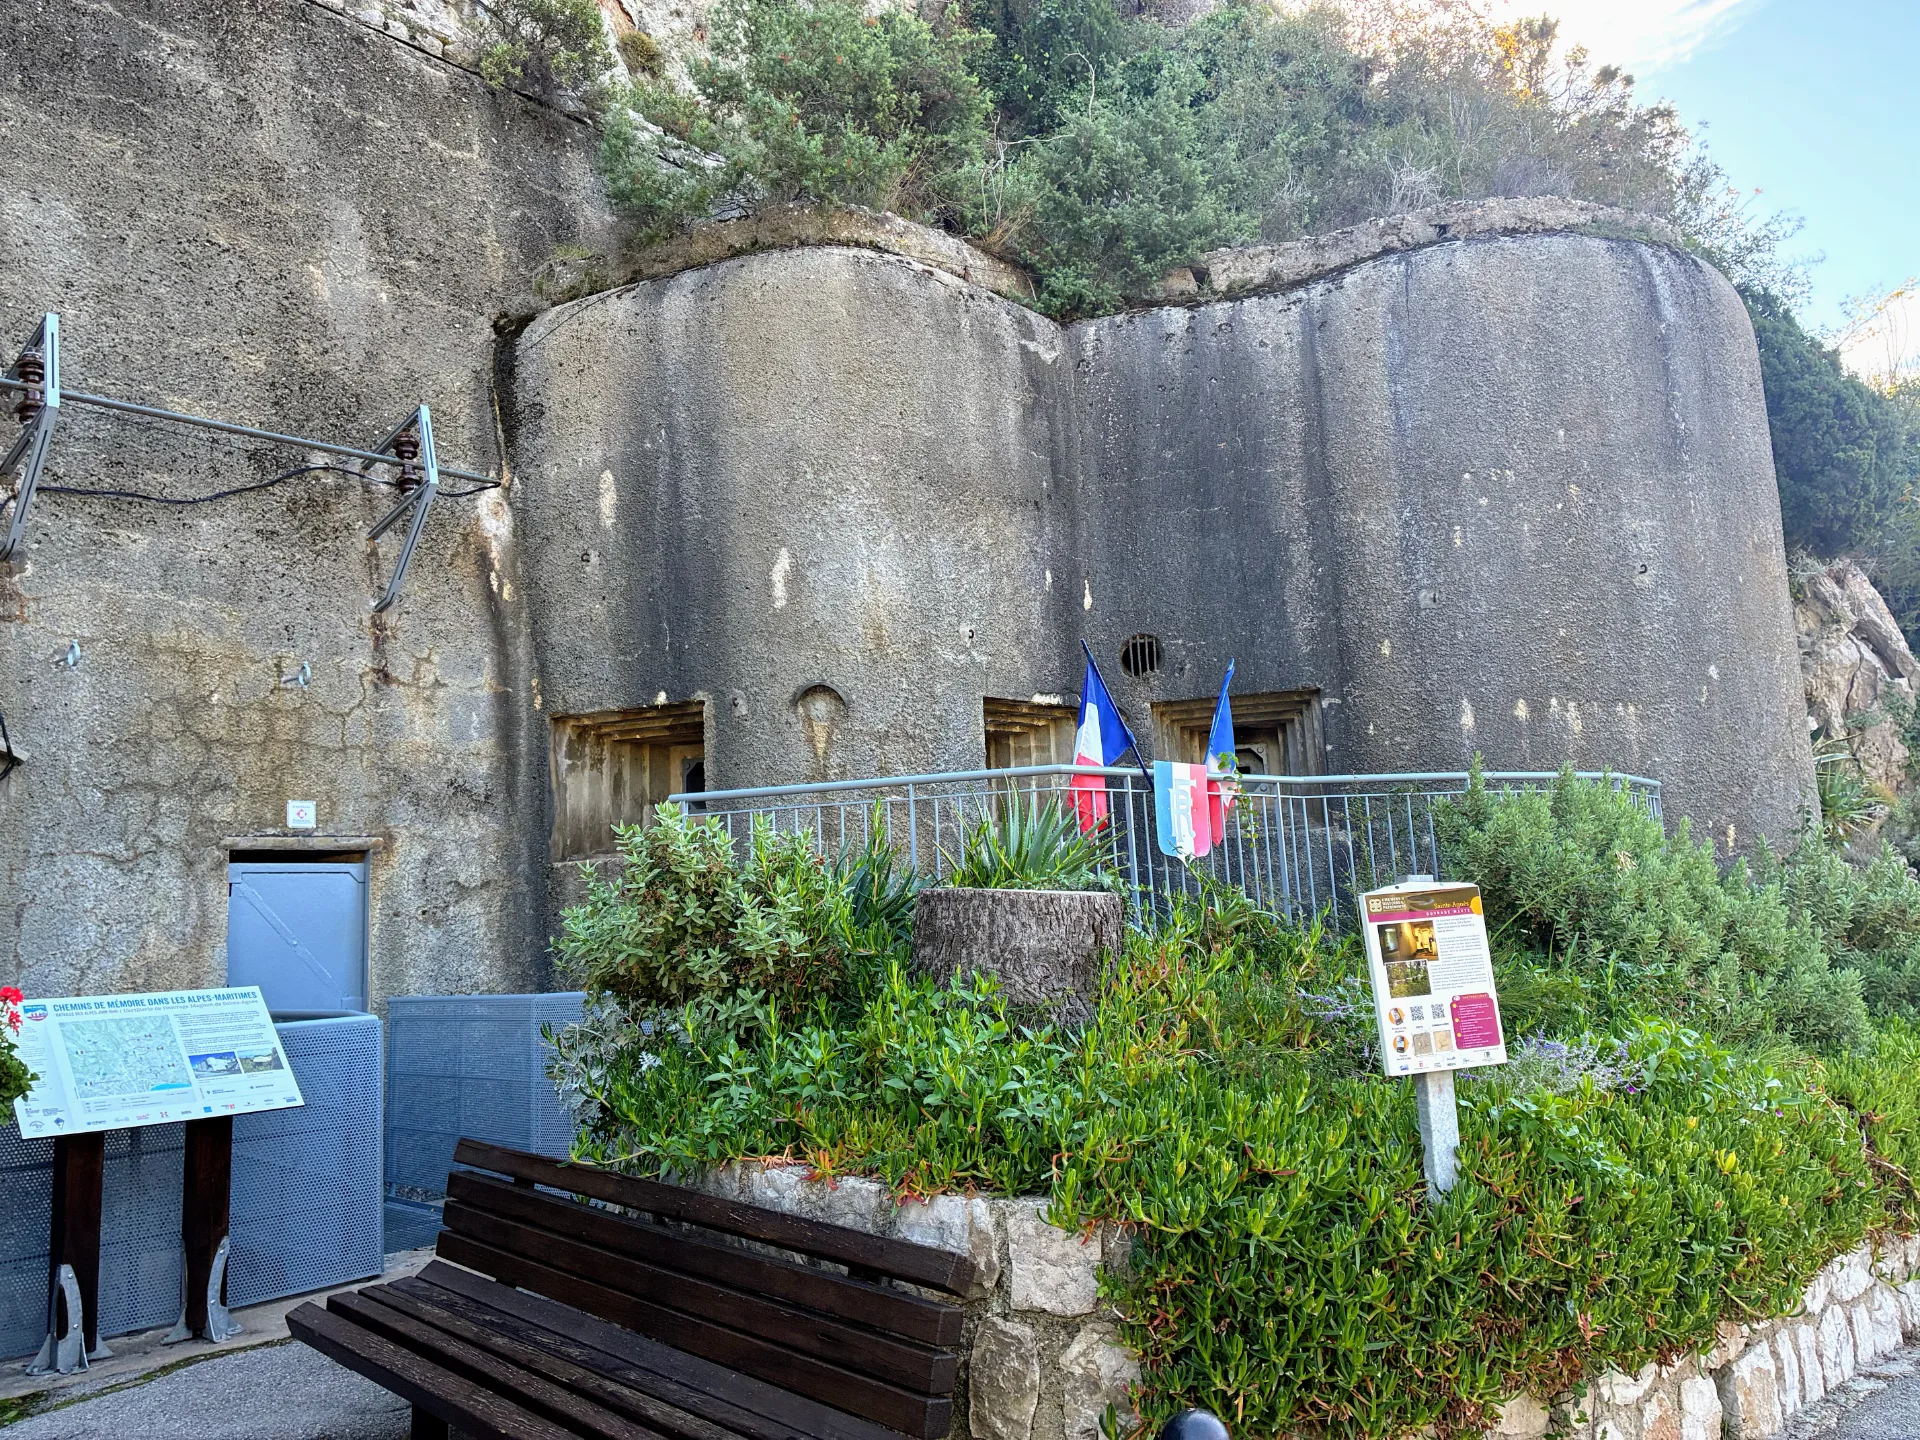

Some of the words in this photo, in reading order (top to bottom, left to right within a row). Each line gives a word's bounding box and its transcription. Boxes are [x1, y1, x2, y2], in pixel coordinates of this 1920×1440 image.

[1433, 901, 1470, 910] Sainte-Agnès
[1426, 909, 1451, 917] OUVRAGE
[53, 1002, 93, 1012] CHEMINS
[94, 1001, 106, 1009] DE
[107, 999, 146, 1009] MÉMOIRE
[147, 997, 170, 1006] DANS
[170, 996, 186, 1004] LES
[187, 991, 258, 1004] ALPES-MARITIMES
